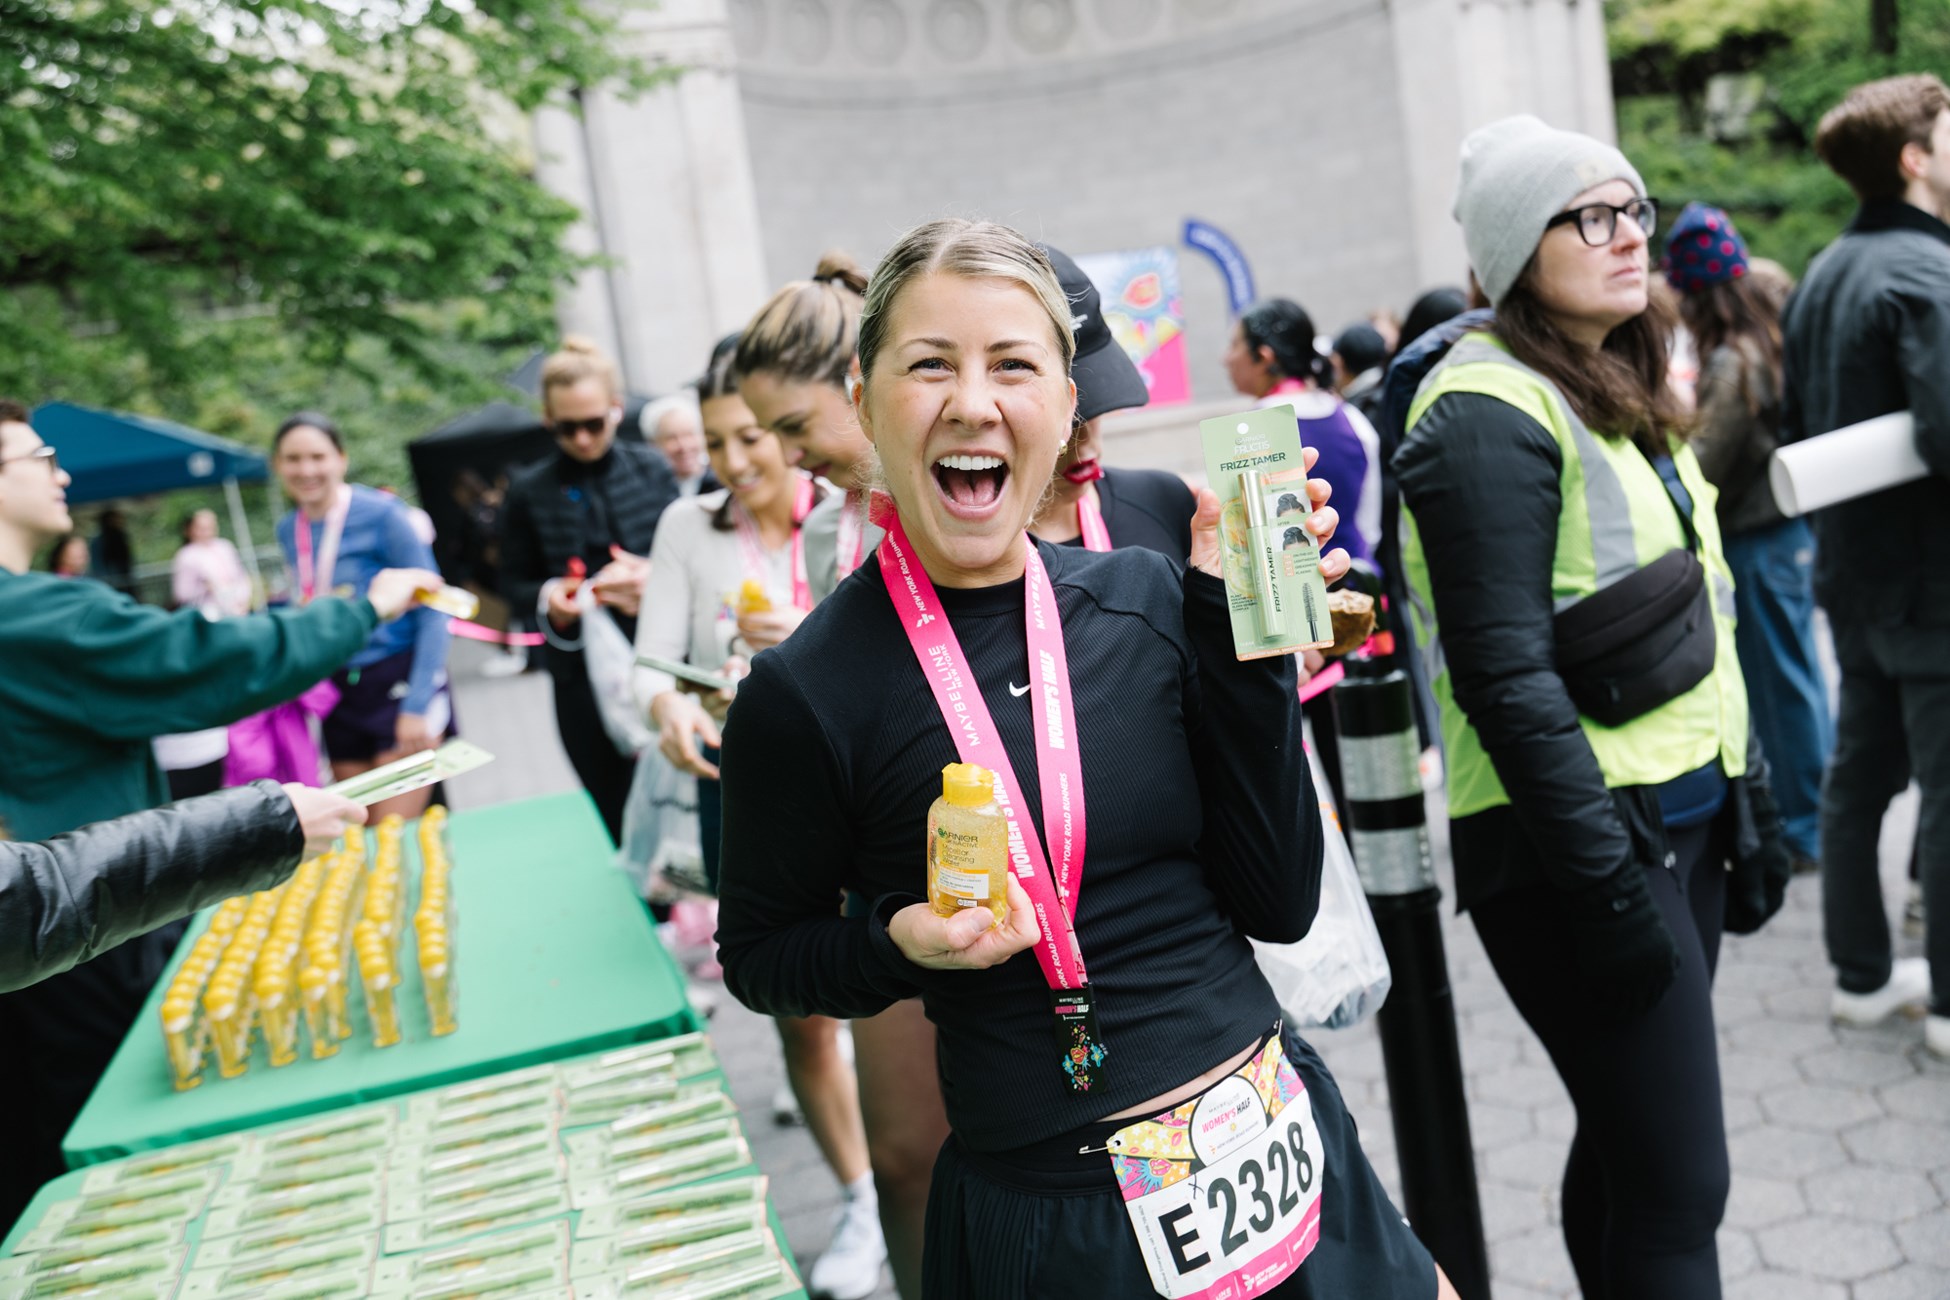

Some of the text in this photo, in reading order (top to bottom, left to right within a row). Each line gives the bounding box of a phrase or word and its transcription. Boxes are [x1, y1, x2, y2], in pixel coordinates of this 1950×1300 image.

[1220, 459, 1249, 471] FRIZZ
[1251, 452, 1286, 466] TAMER
[899, 557, 910, 575] ROAD
[904, 575, 918, 595] YORK
[1266, 547, 1282, 612] FRIZZ TAMER
[913, 595, 926, 611] NEW
[940, 644, 963, 688] NEW YORK
[928, 645, 980, 747] MAYBELLINE
[1039, 648, 1065, 750] WOMEN'S HALF
[938, 828, 978, 842] GARNIER
[1059, 772, 1072, 883] NEW YORK ROAD RUNNERS
[1035, 902, 1054, 942] RUNNERS
[1048, 943, 1062, 967] ROAD
[1202, 1097, 1251, 1133] WOMEN'S HALF
[1158, 1121, 1313, 1276] E 2328
